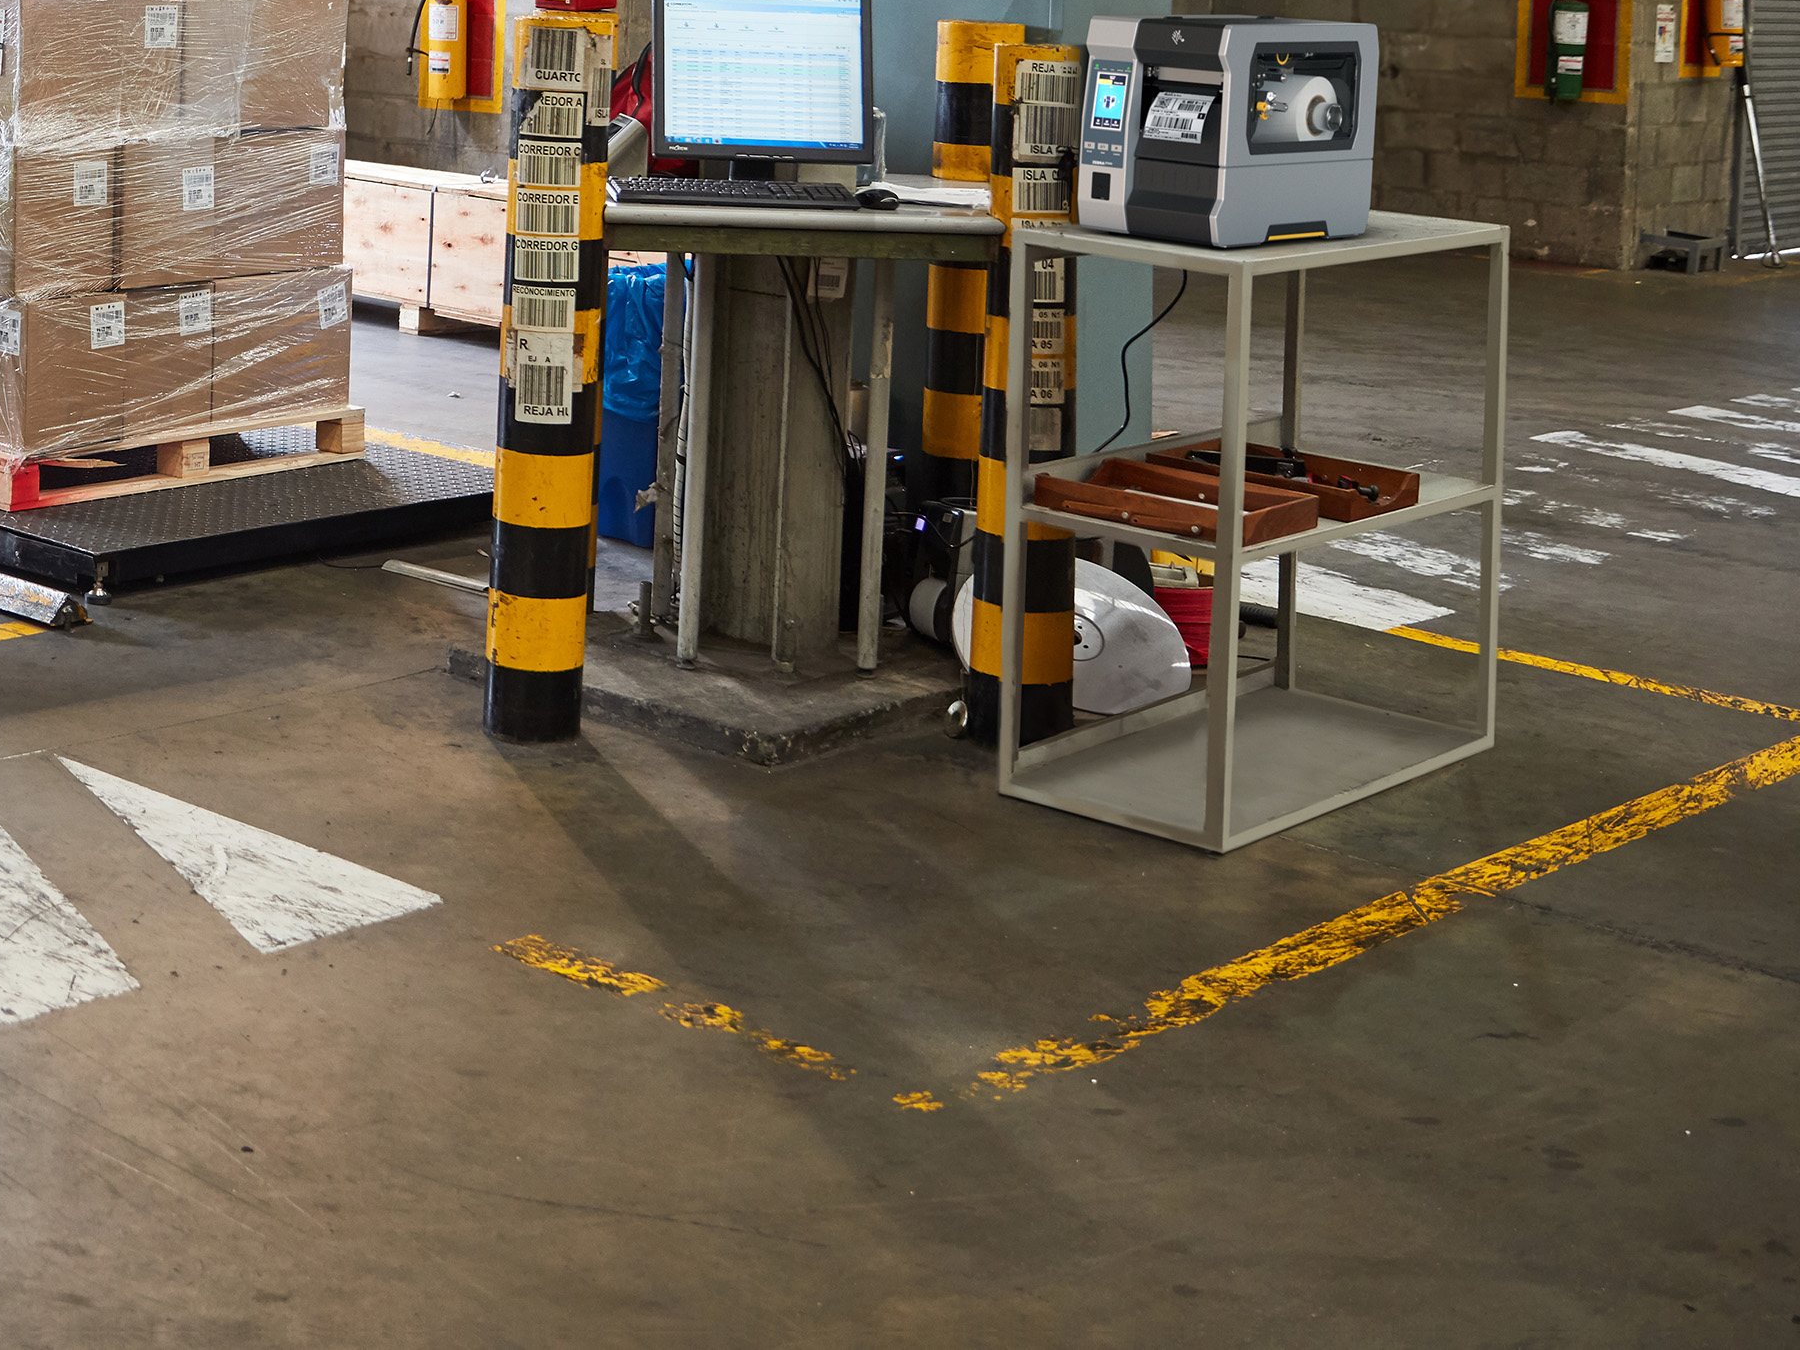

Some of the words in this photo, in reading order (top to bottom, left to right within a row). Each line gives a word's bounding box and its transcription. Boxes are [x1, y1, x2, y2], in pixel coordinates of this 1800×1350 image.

[1031, 62, 1056, 74] REJA
[540, 95, 573, 107] REDOR
[576, 97, 582, 107] A
[518, 143, 571, 156] CORREDOR
[1029, 144, 1053, 155] ISLA
[1023, 169, 1047, 181] ISLA
[516, 191, 570, 204] CORREDOR
[572, 194, 579, 204] E
[515, 238, 568, 251] CORREDOR
[570, 241, 578, 251] G
[1041, 258, 1054, 270] 04
[512, 285, 576, 297] RECONOCIMIENTO
[1040, 389, 1053, 399] 06
[523, 405, 554, 417] REJA
